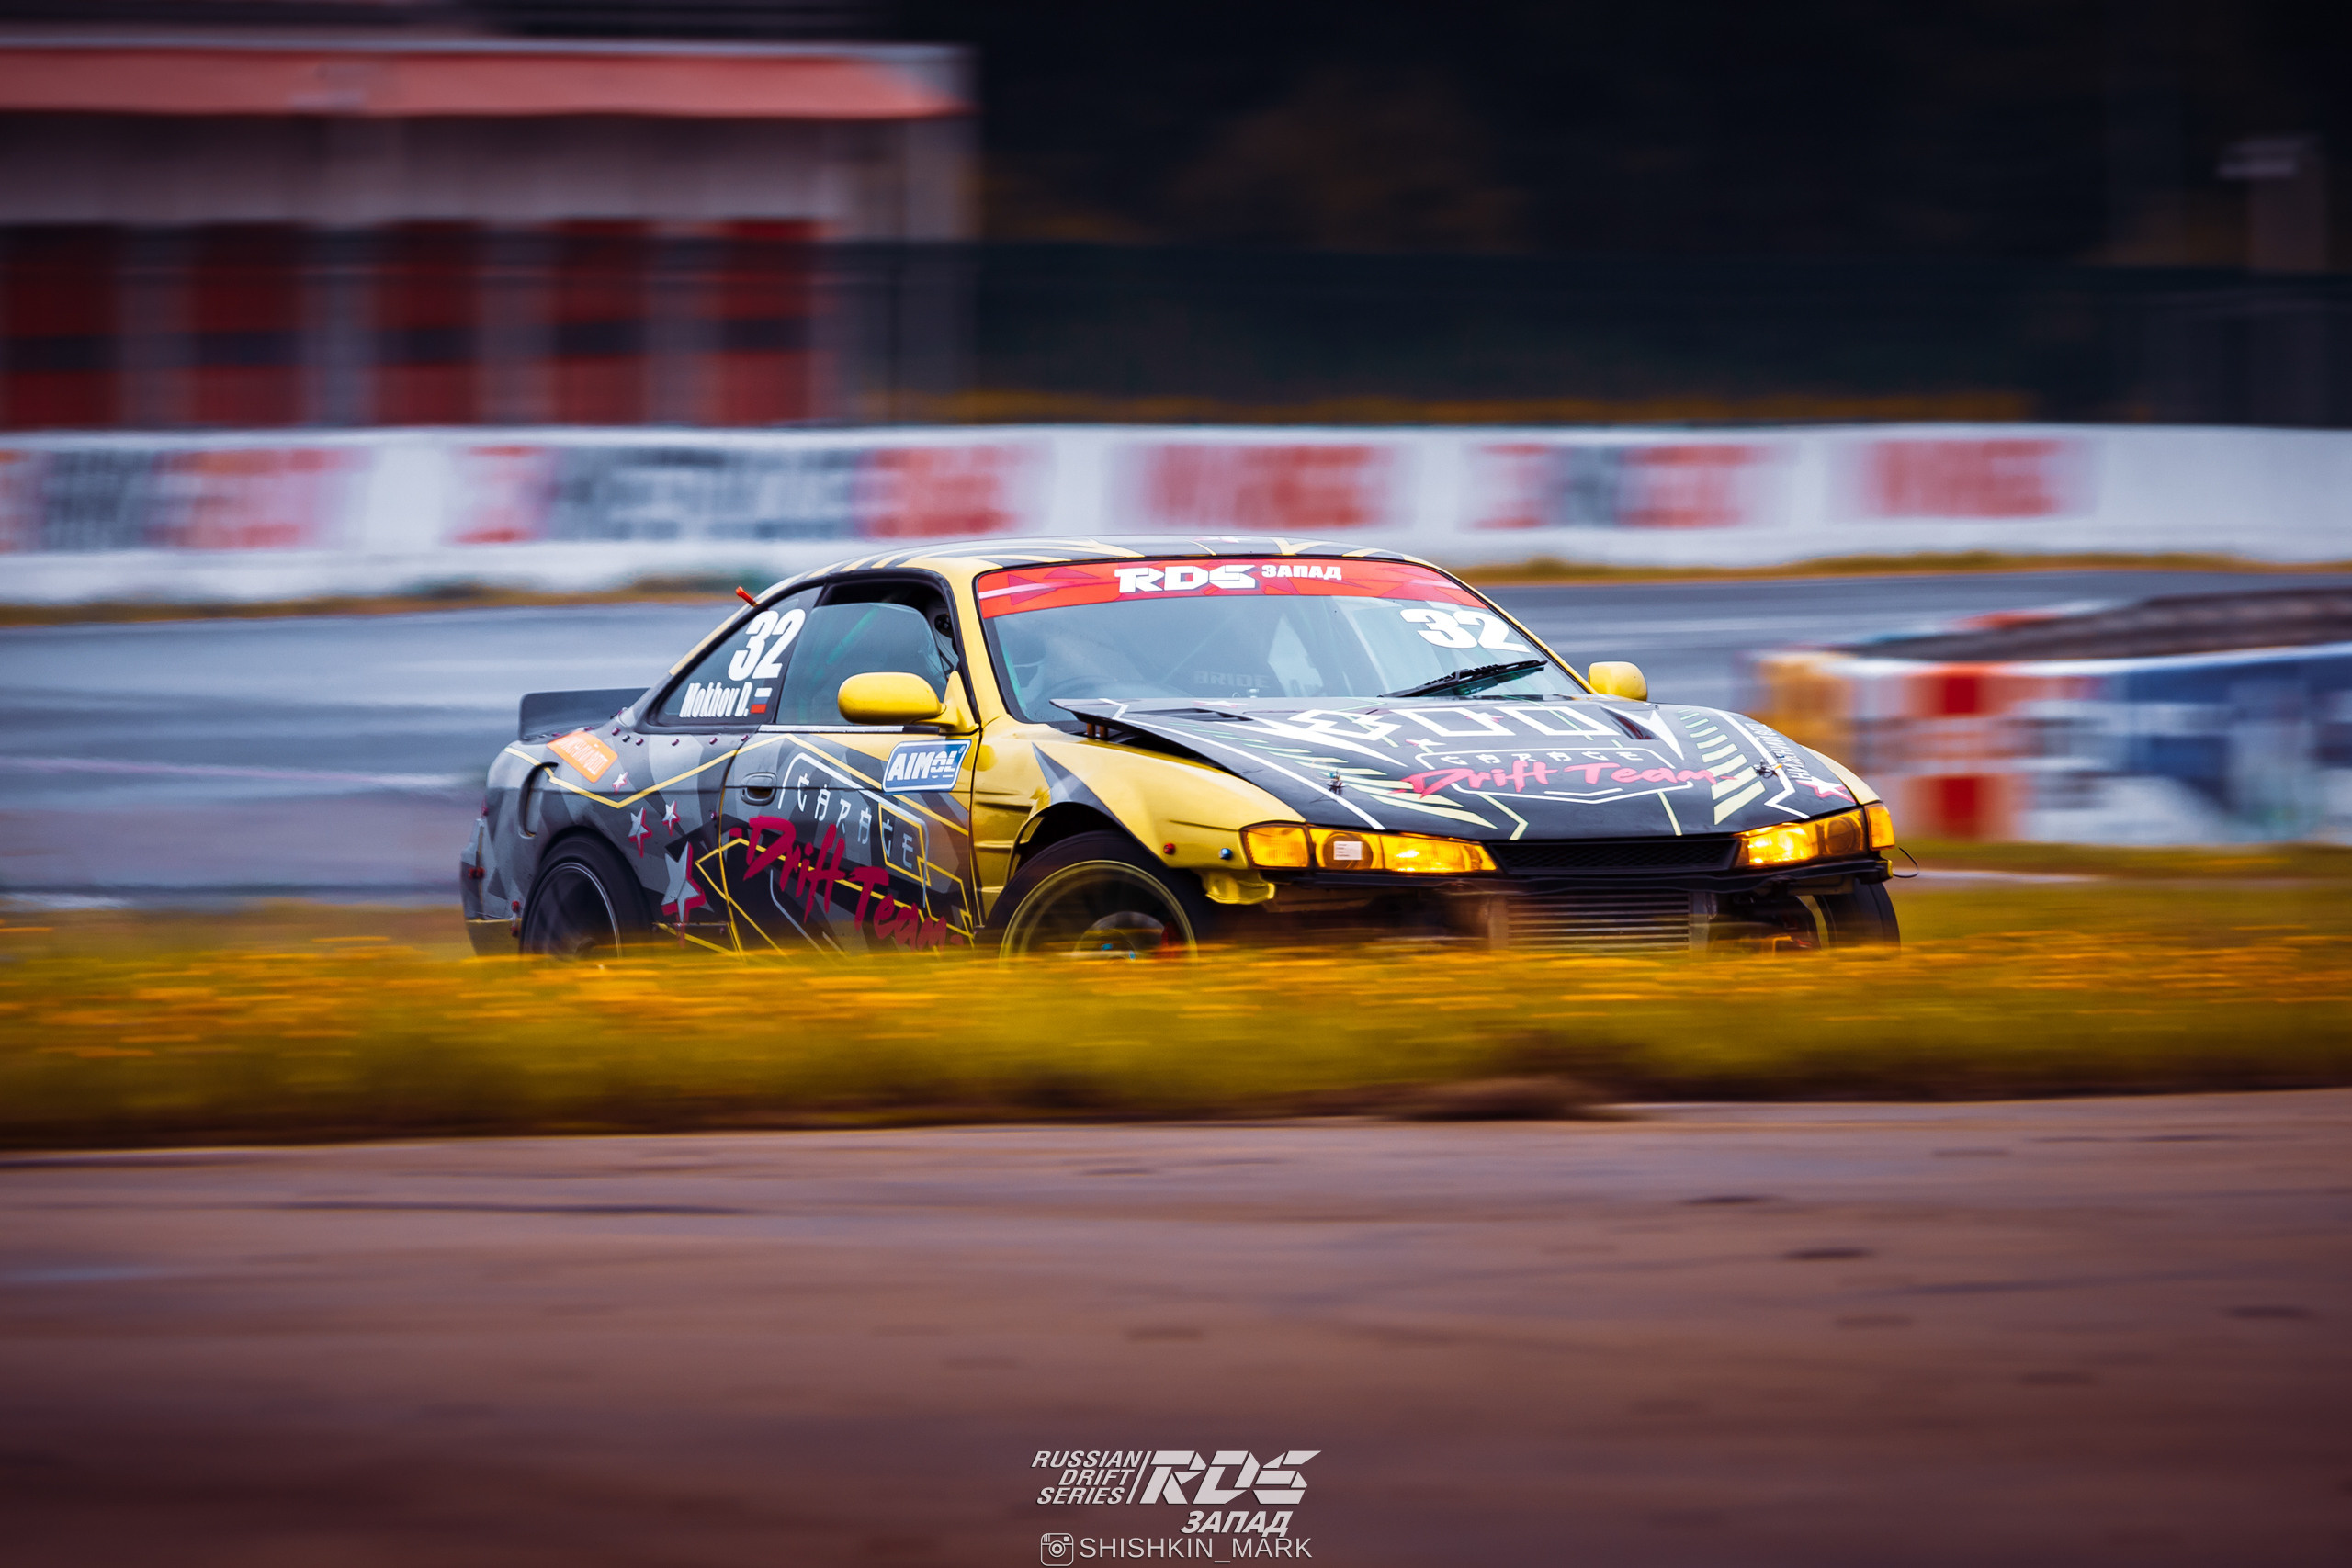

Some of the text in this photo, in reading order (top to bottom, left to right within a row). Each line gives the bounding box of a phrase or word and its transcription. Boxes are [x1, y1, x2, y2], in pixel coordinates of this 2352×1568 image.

[1114, 564, 1257, 593] RDS
[1261, 565, 1342, 581] ЗАПАД
[728, 608, 806, 681] 32
[1400, 608, 1531, 653] 32
[679, 682, 753, 717] Mokhov D.
[887, 750, 958, 781] AIMOL
[1440, 750, 1644, 766] GARAGE
[1400, 760, 1559, 799] Drift
[797, 773, 914, 869] GARAGE
[742, 815, 846, 923] Drift
